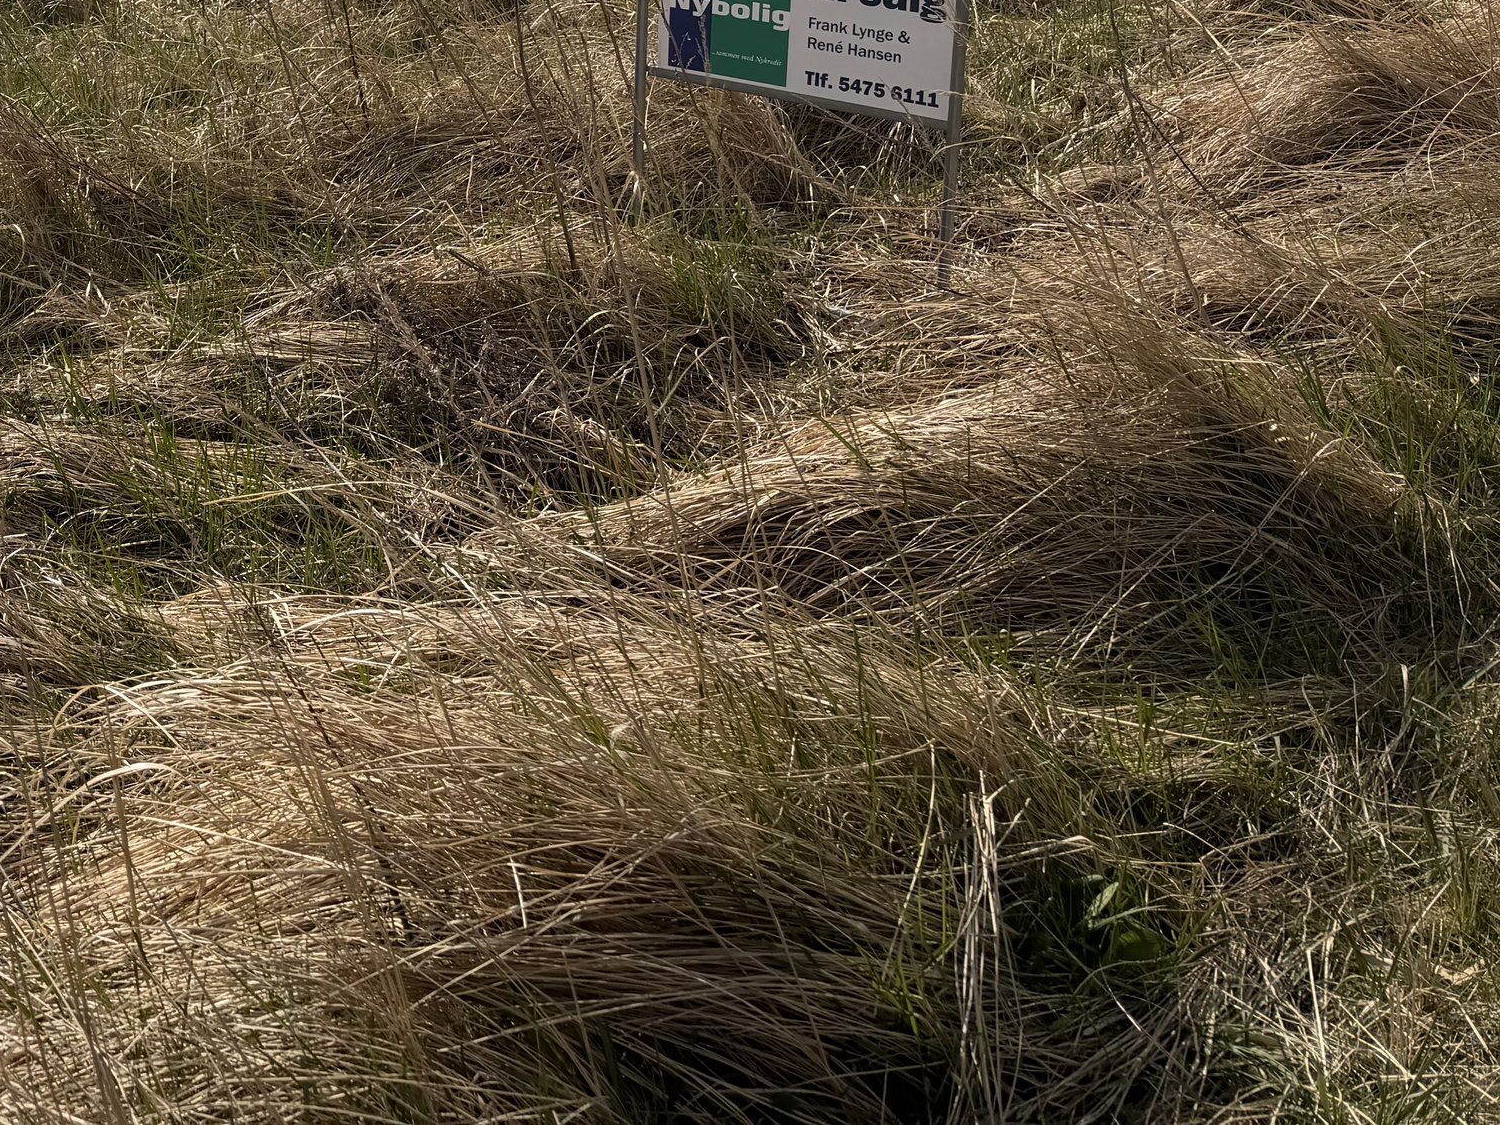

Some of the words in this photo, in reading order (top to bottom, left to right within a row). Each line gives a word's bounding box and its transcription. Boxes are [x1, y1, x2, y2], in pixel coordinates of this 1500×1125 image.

[808, 16, 848, 35] Frank
[852, 23, 894, 43] Lynge
[898, 30, 911, 44] &
[807, 36, 843, 54] René
[848, 42, 902, 63] Hansen
[805, 70, 833, 89] Tlf.
[838, 76, 886, 98] 5475
[891, 85, 939, 108] 6111
